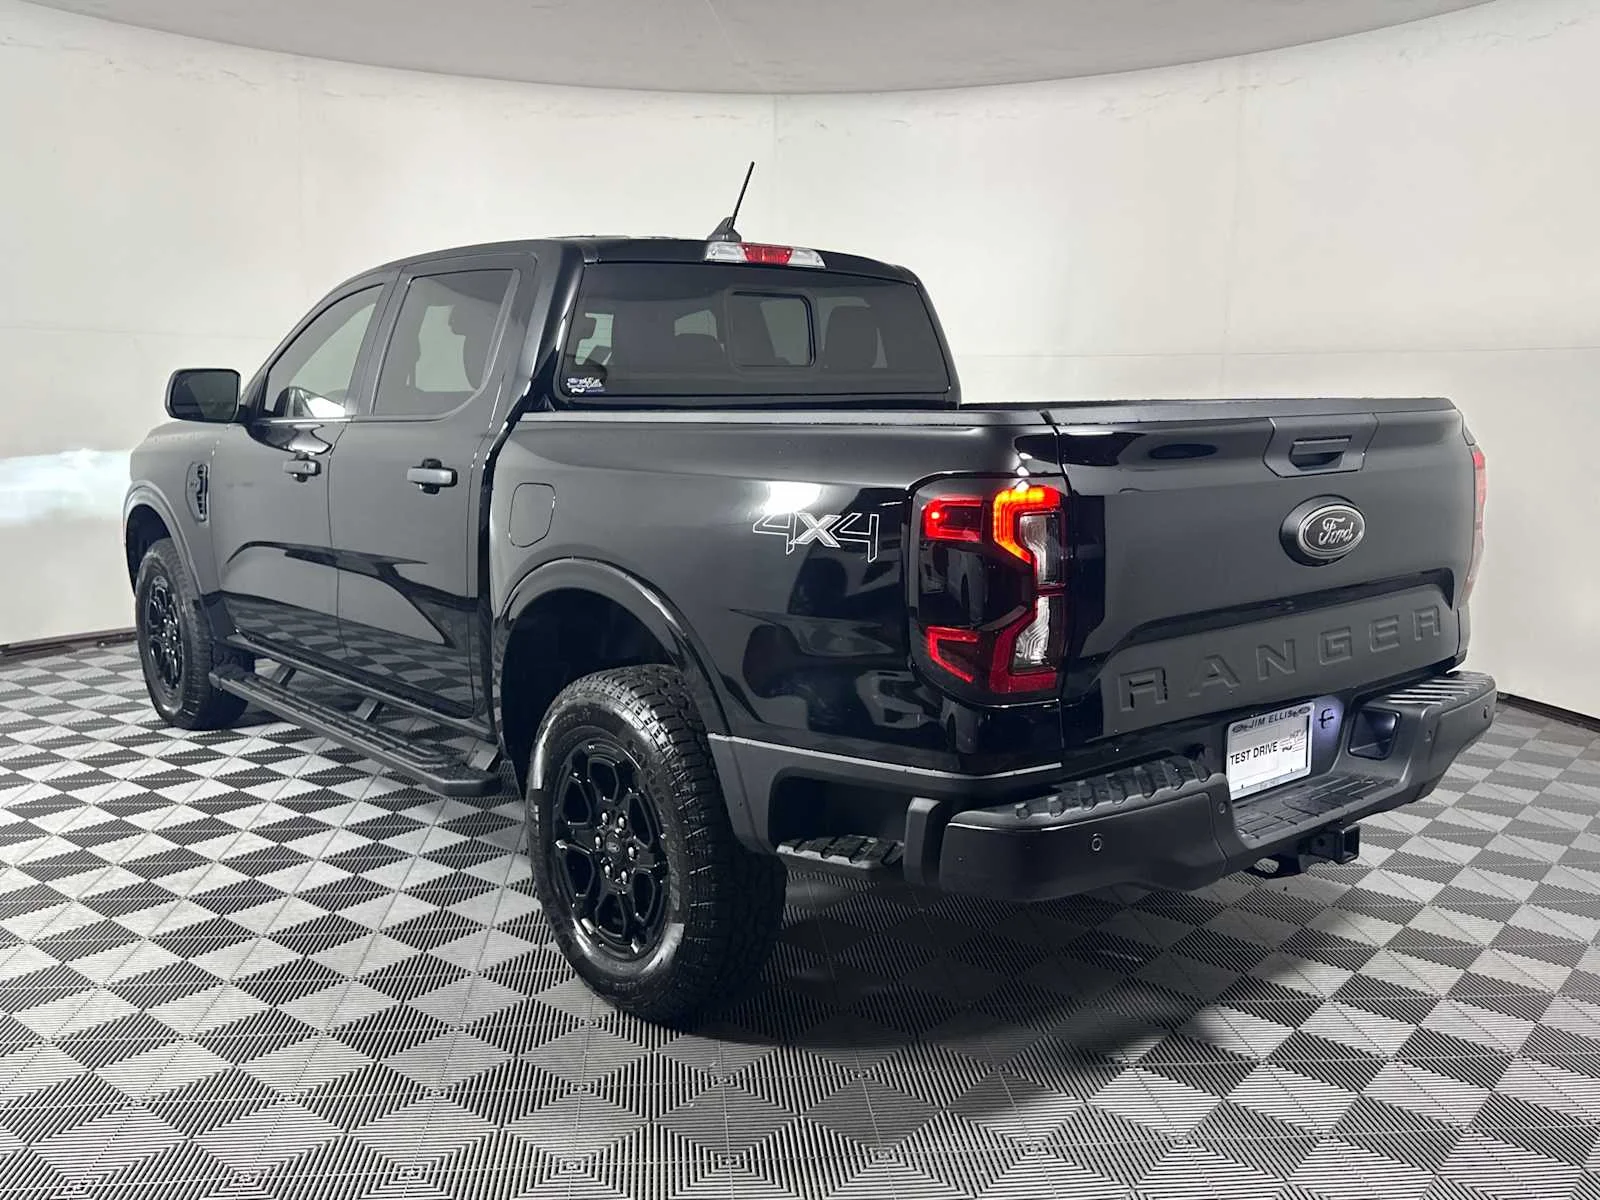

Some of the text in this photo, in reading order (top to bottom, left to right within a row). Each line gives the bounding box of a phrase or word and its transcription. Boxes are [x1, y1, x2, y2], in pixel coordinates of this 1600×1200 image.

[1318, 517, 1354, 545] Ford
[1118, 605, 1441, 713] RANGER
[1249, 710, 1293, 729] JIM ELLIS
[1230, 741, 1278, 765] TEST DRIVE
